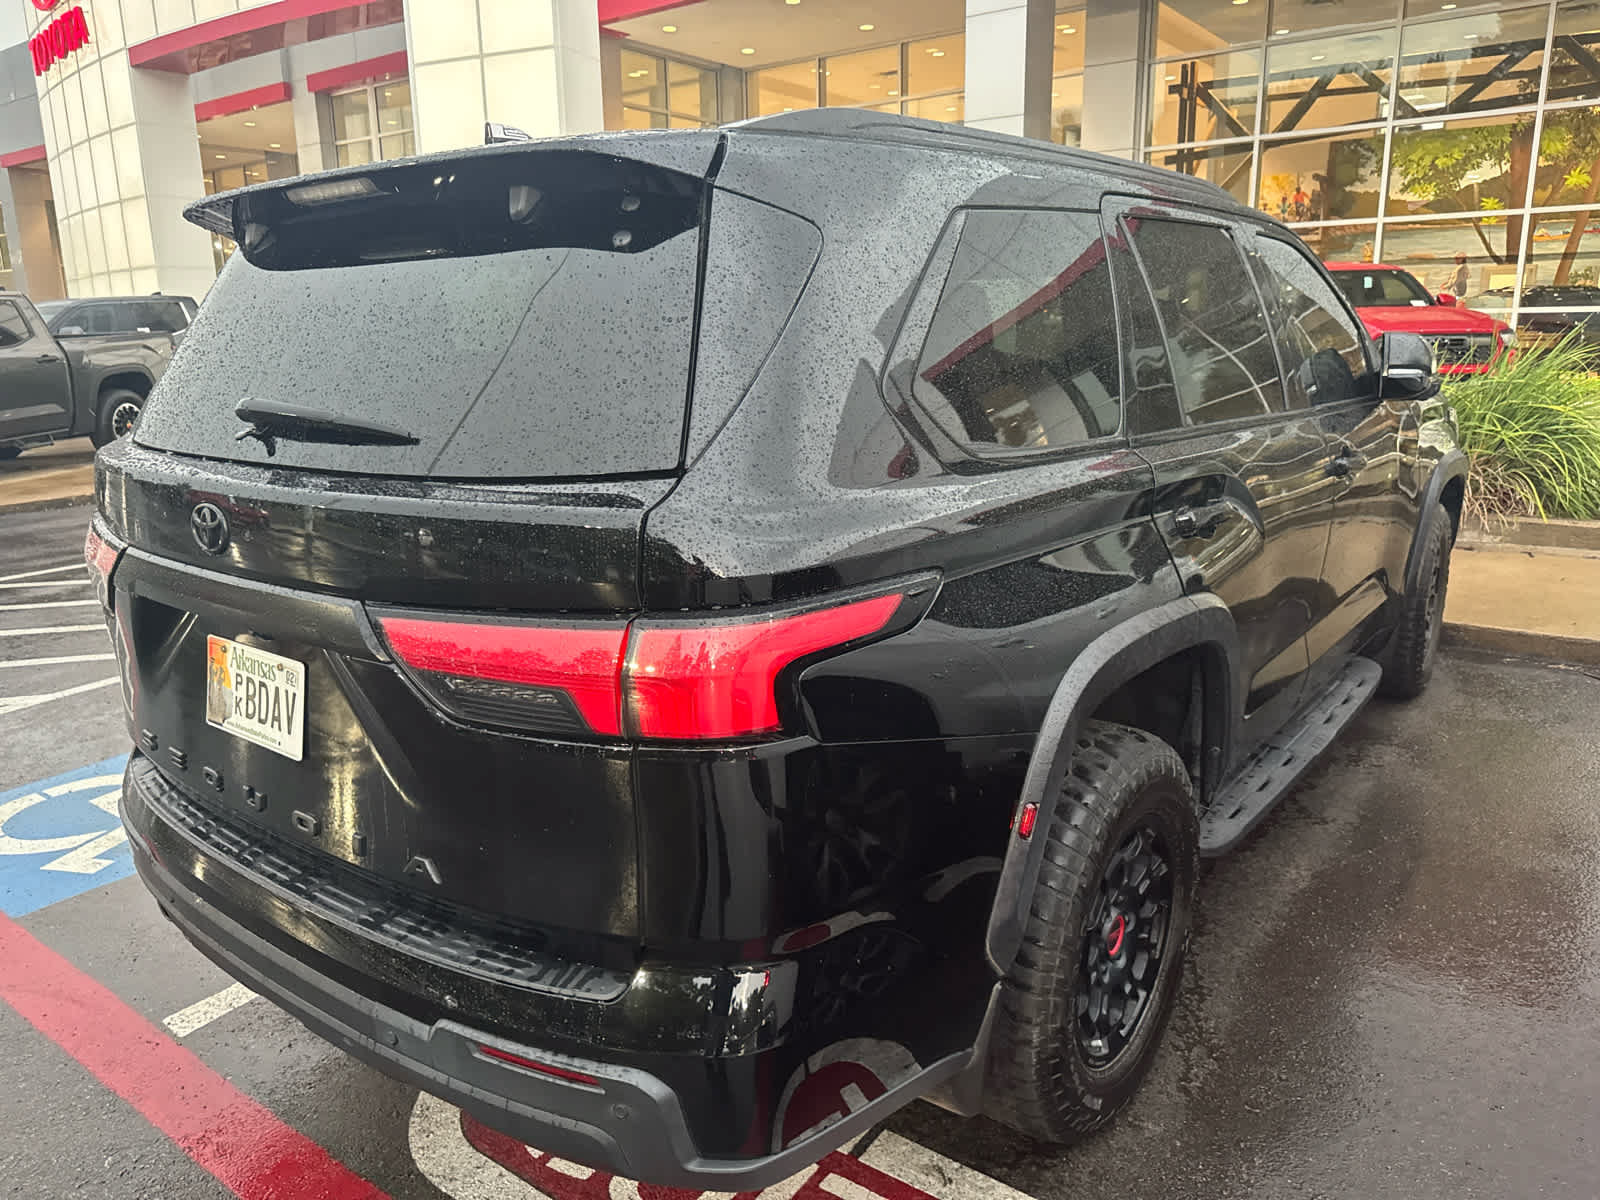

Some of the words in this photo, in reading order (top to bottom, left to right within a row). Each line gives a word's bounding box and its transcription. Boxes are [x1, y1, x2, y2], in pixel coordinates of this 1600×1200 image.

[27, 6, 90, 76] TOYOTA
[230, 646, 277, 682] Arkansas
[246, 679, 297, 735] BDAV
[141, 729, 442, 884] SEQUOIA
